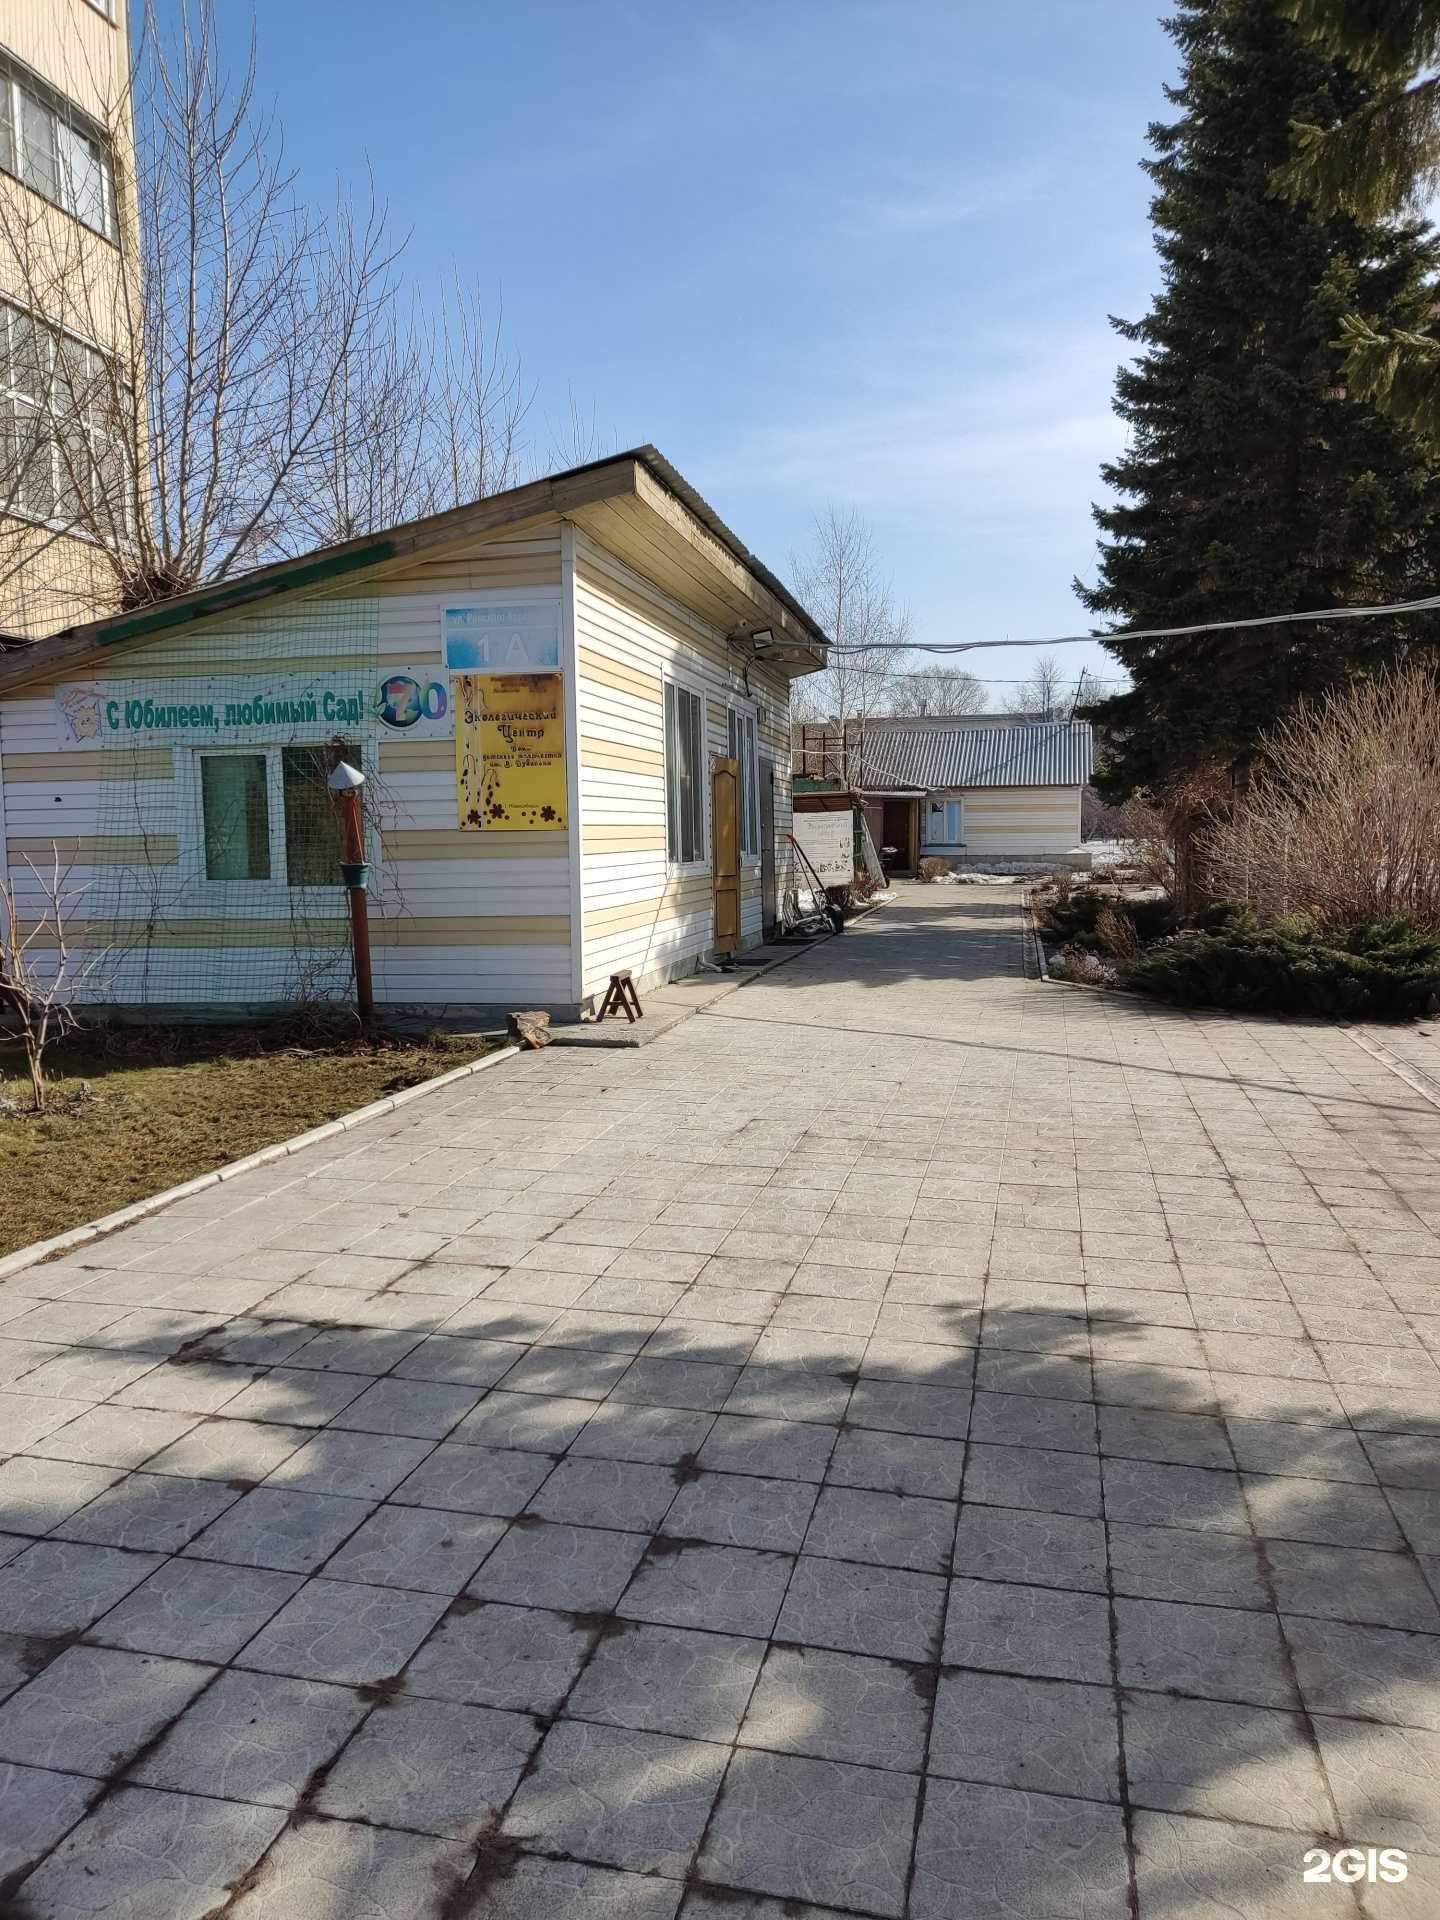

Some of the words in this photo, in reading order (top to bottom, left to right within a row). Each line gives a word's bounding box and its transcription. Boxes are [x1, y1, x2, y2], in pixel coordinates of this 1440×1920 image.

[106, 700, 120, 730] С
[125, 699, 220, 733] Юбилеем,
[223, 692, 317, 727] любимый
[322, 689, 365, 727] Сад!
[385, 682, 448, 721] 70
[497, 724, 545, 743] Центр
